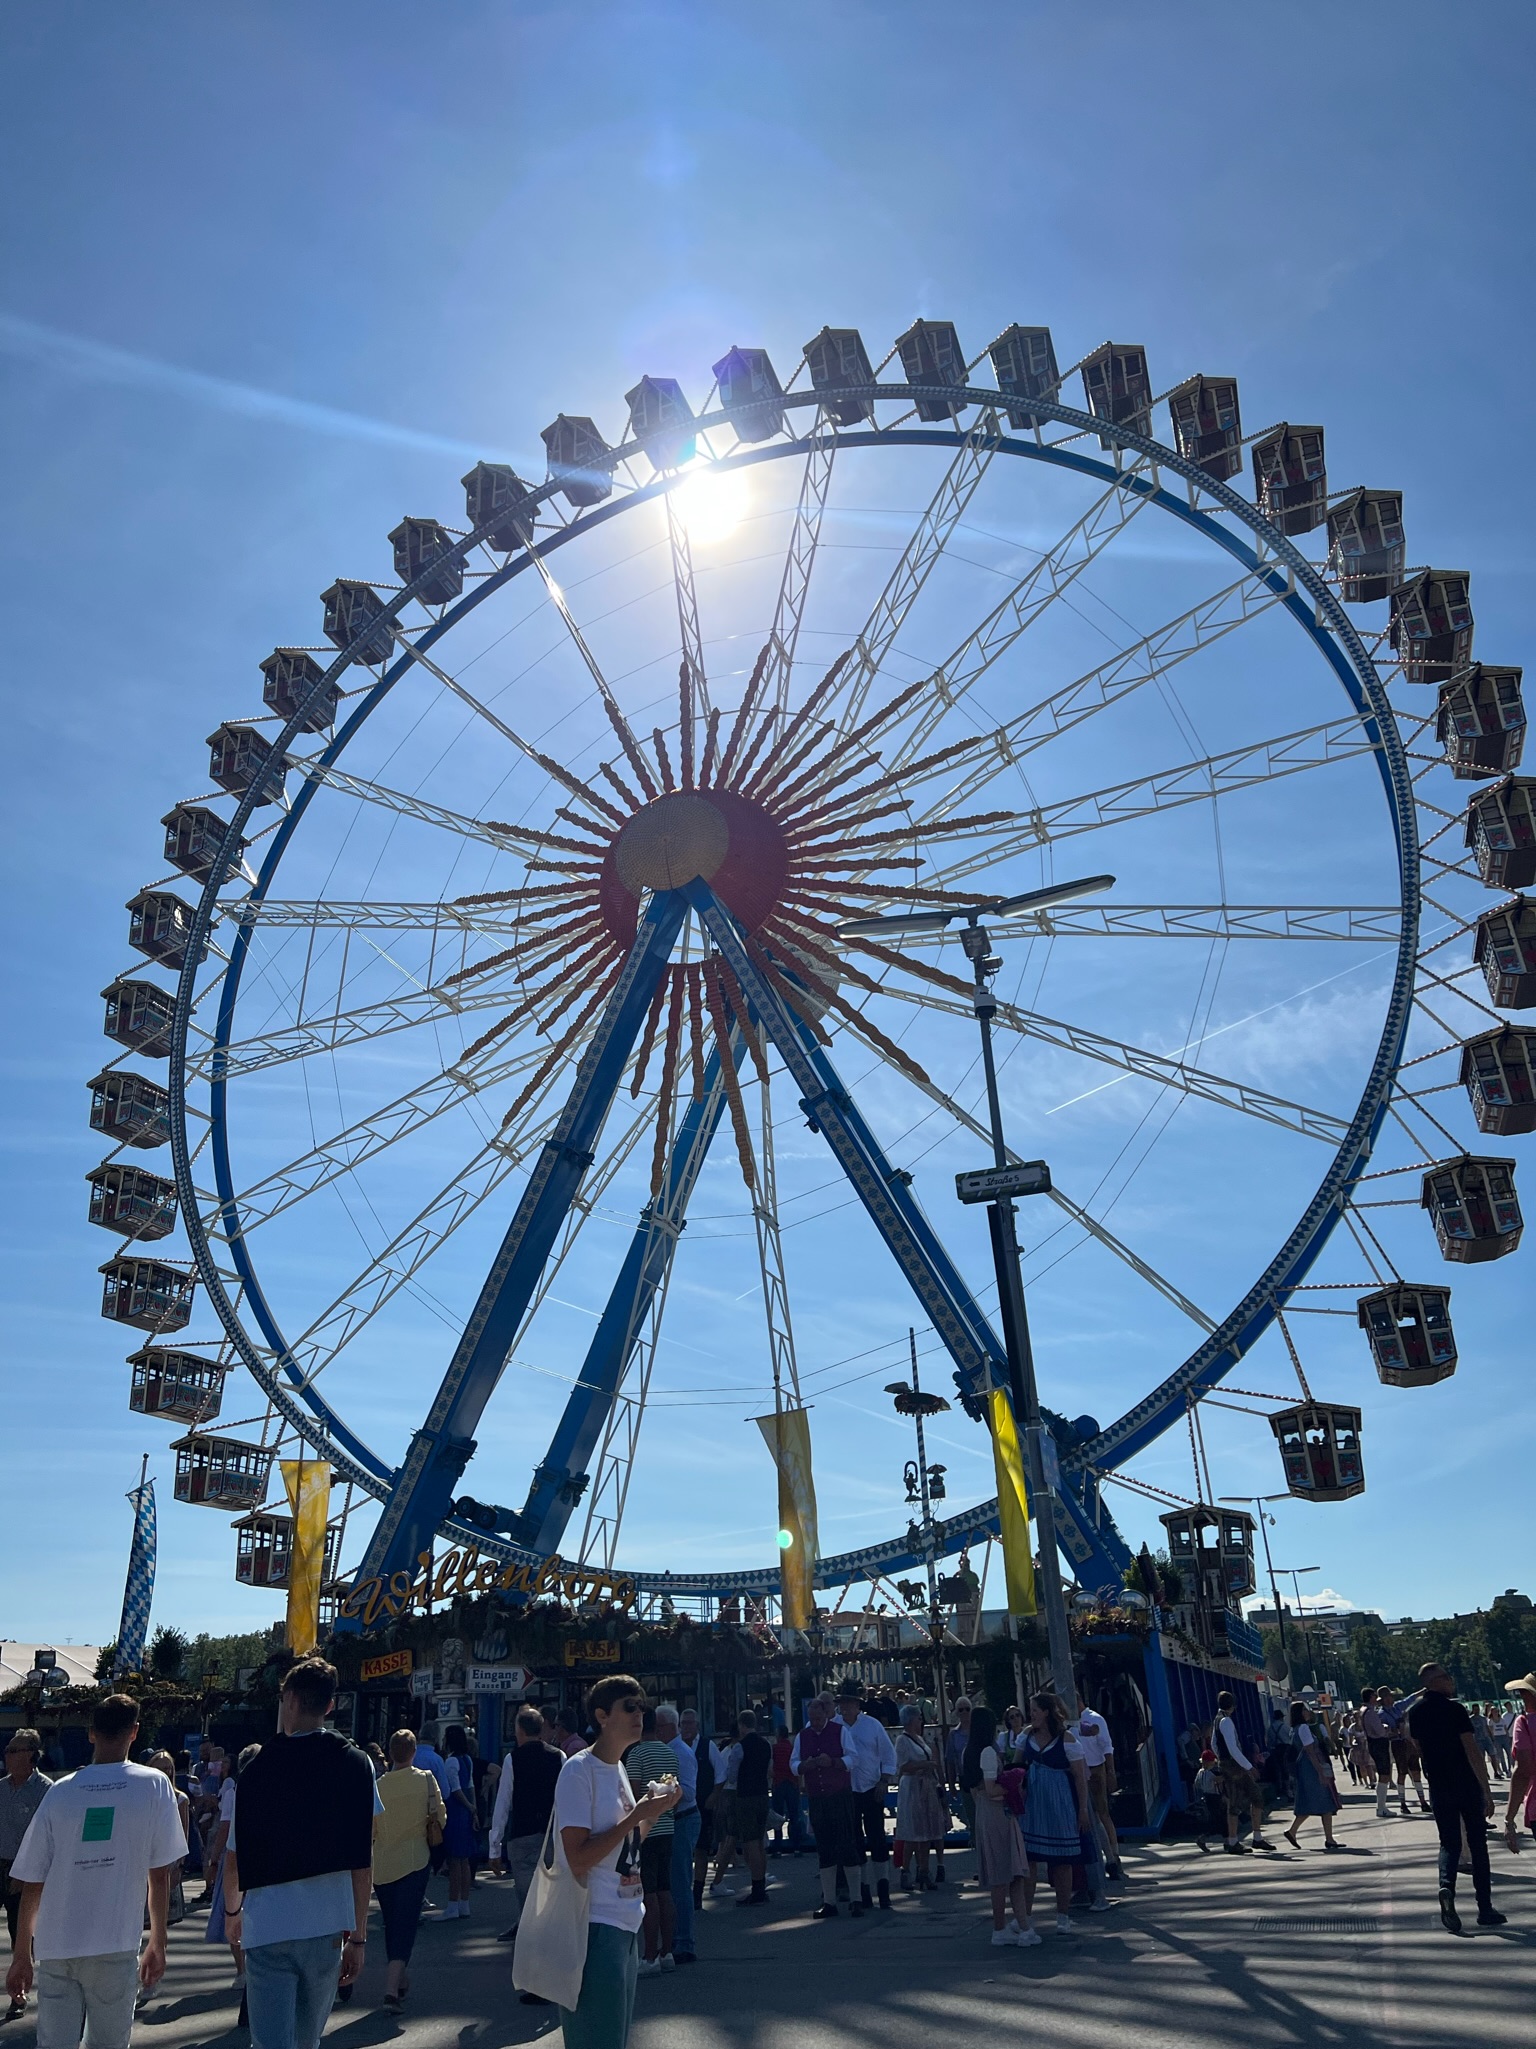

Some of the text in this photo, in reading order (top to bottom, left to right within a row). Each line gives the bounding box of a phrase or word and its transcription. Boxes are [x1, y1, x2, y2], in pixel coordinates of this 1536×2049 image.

[340, 1544, 637, 1625] Willenborg
[364, 1652, 408, 1675] KASSE
[471, 1669, 519, 1683] Eingang
[474, 1681, 500, 1689] Kasse
